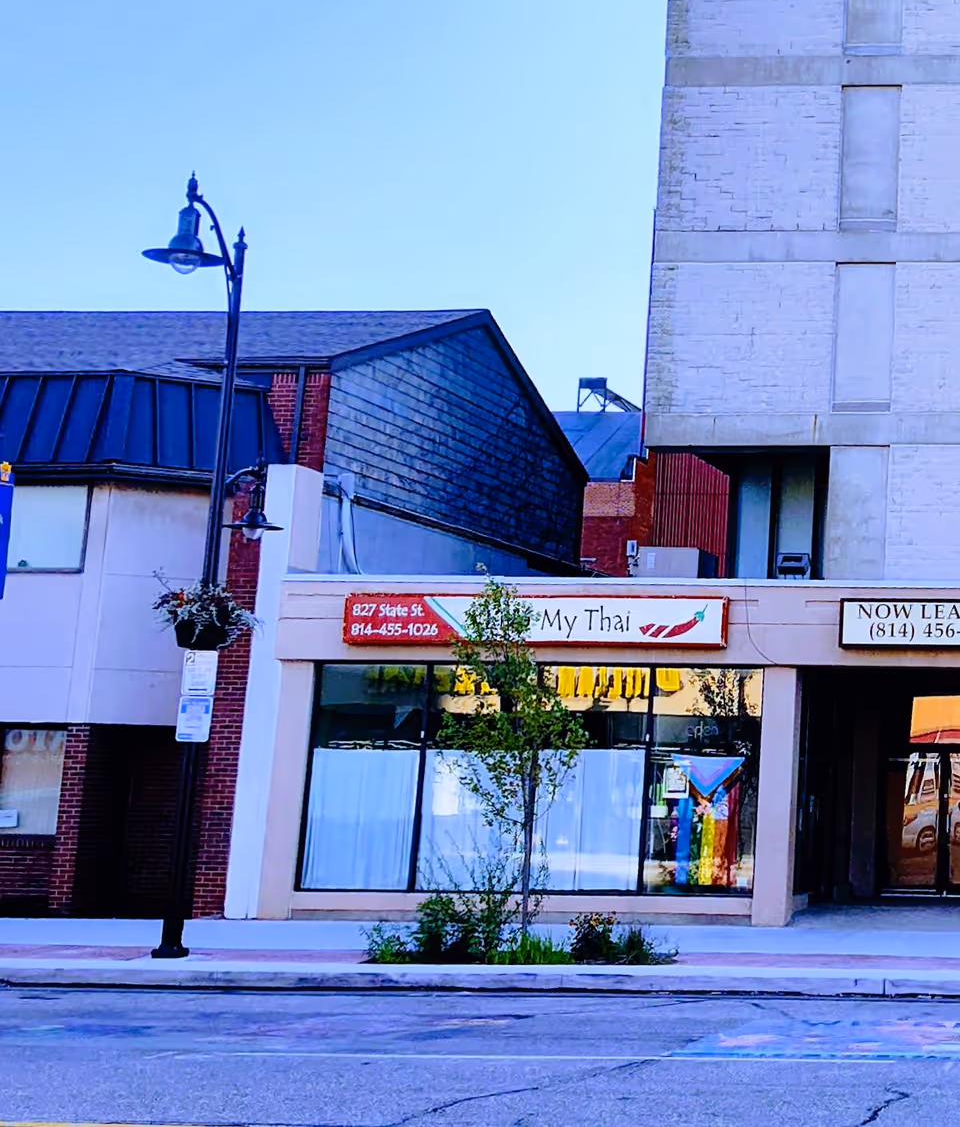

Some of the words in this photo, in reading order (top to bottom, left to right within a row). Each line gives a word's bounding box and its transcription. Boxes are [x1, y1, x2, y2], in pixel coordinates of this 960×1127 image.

[352, 603, 374, 617] 827
[378, 603, 408, 617] State
[410, 603, 425, 617] St.
[857, 603, 914, 620] NOW
[350, 623, 439, 636] 814-455-1026
[541, 609, 578, 638] My
[584, 605, 631, 633] Thai
[869, 622, 916, 642] (814)
